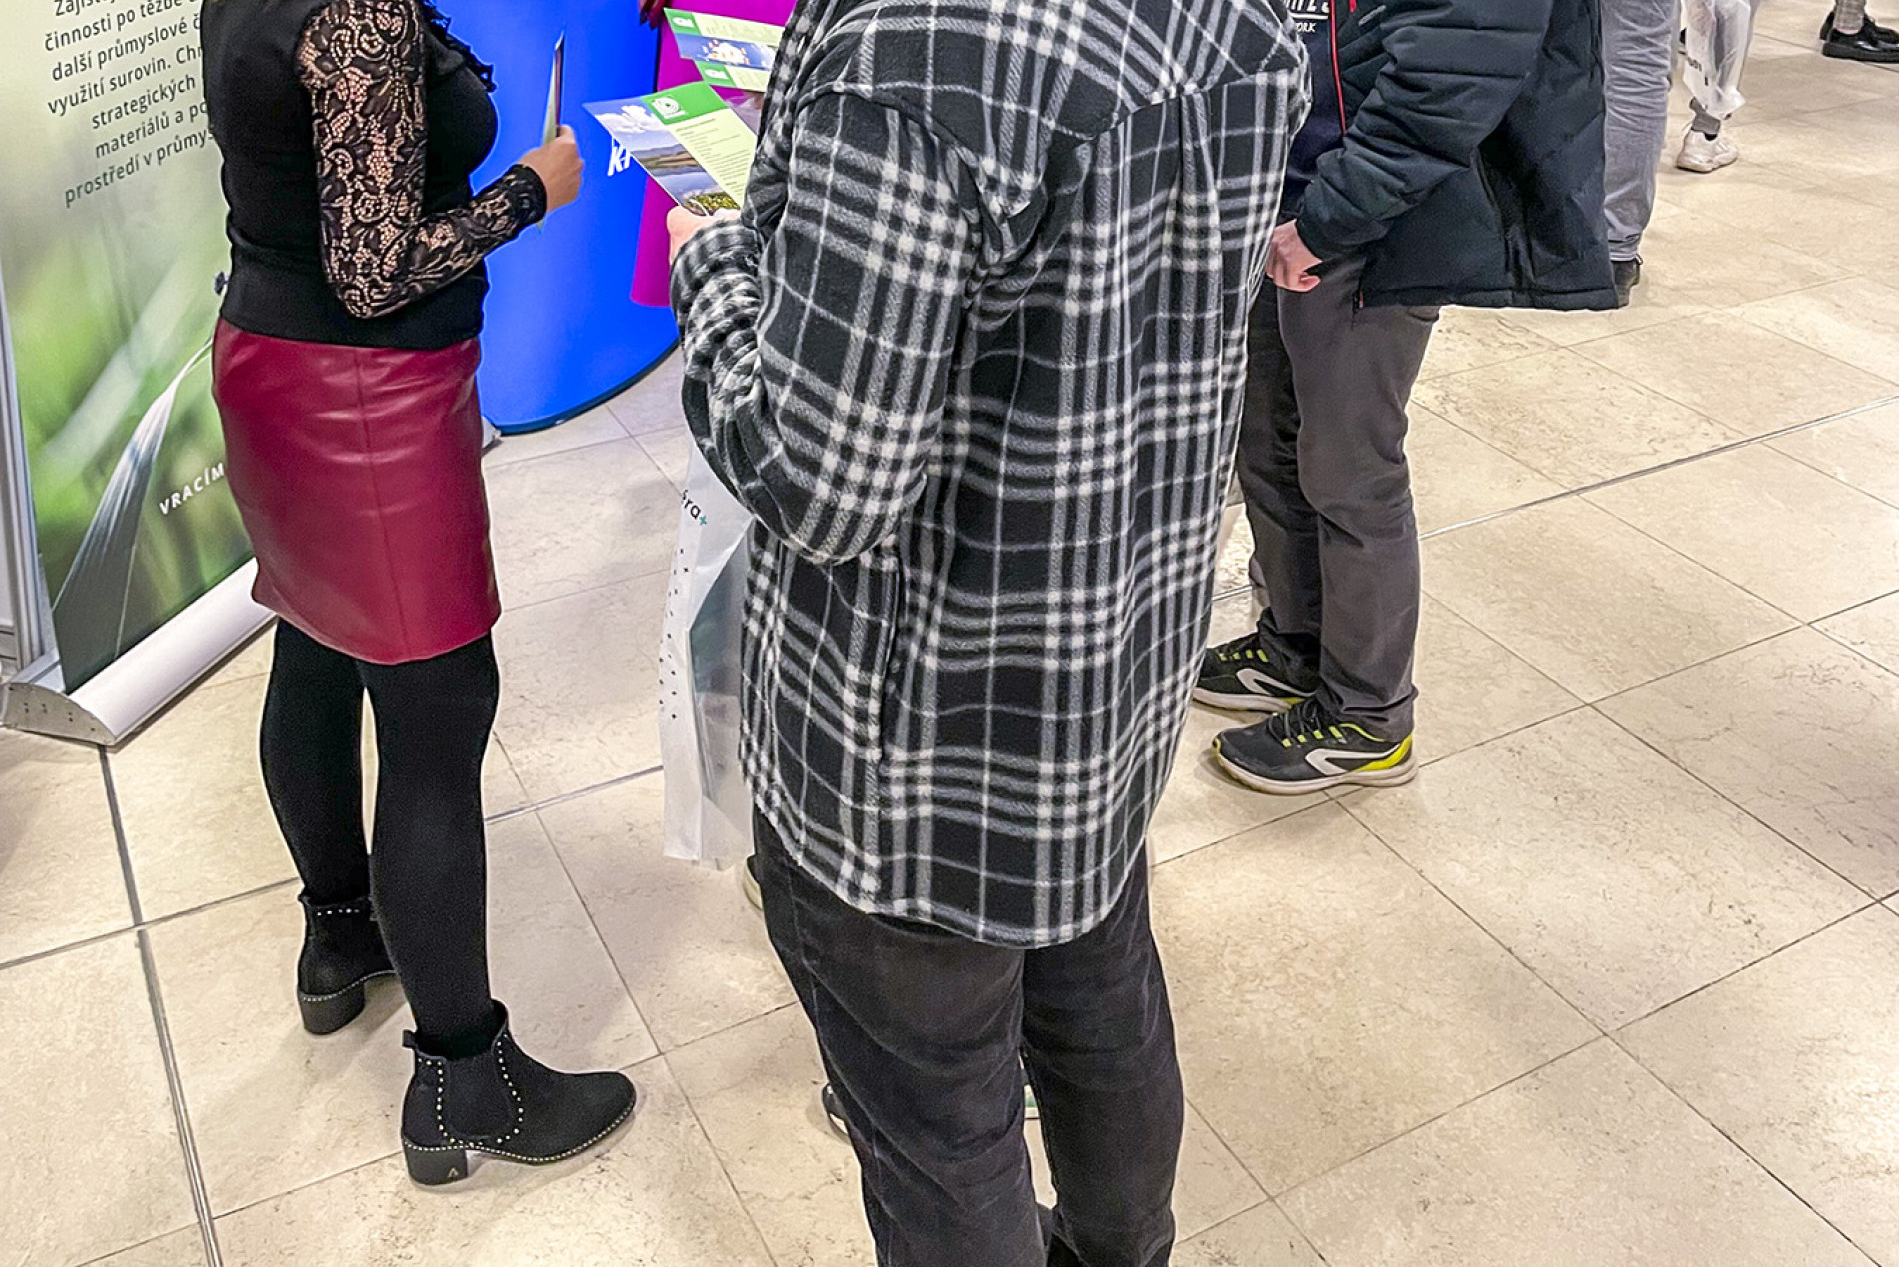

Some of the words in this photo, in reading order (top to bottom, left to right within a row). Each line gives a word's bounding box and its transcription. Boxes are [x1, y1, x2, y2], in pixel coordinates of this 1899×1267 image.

[45, 13, 112, 52] činnosti
[117, 9, 136, 32] po
[52, 50, 93, 81] další
[97, 17, 188, 69] průmyslové
[48, 77, 105, 116] využití
[109, 56, 172, 92] surovin.
[92, 74, 196, 130] strategických
[95, 110, 170, 159] materiálů
[175, 110, 184, 125] a
[65, 154, 140, 209] prostředí
[143, 153, 153, 166] v
[156, 129, 212, 166] průmy
[159, 462, 225, 515] VRACÍM
